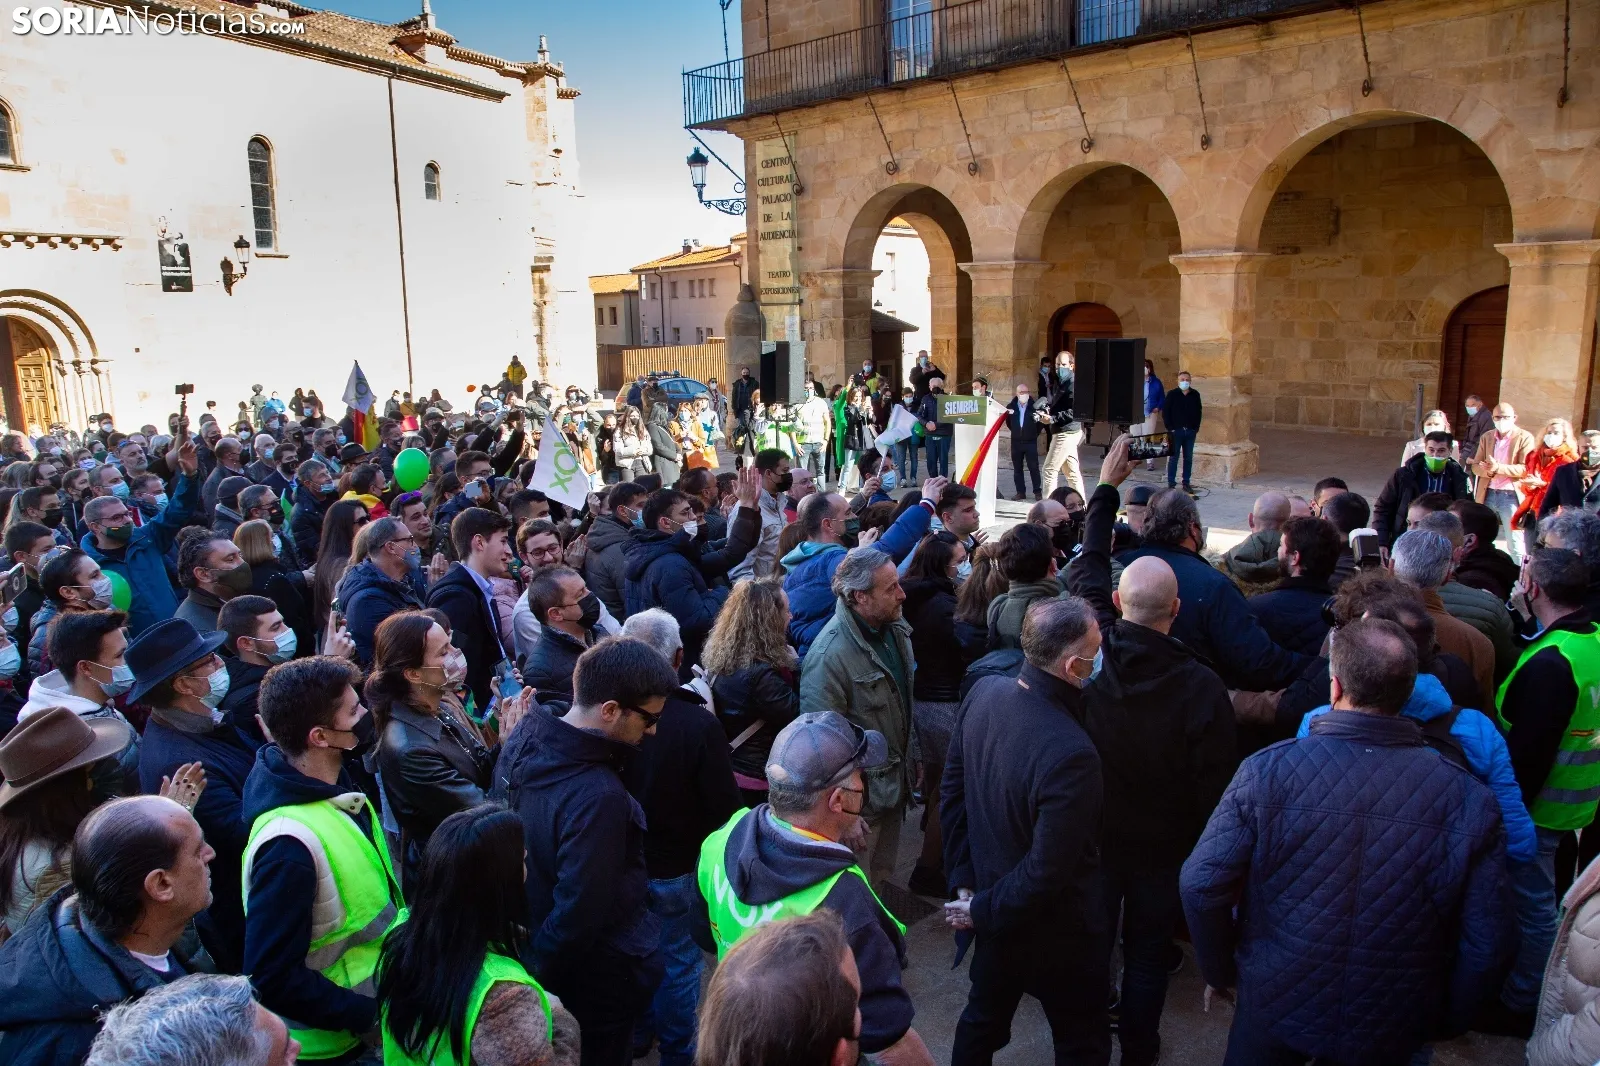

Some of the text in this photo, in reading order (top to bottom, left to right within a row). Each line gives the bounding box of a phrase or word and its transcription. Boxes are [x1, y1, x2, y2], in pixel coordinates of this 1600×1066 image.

[761, 157, 790, 168] CENTRO
[757, 174, 795, 187] CULTURAL
[762, 193, 791, 205] PALACIO
[763, 211, 792, 223] DE LA
[760, 229, 797, 241] AUDIENCIA
[768, 270, 791, 279] TEATRO
[760, 285, 799, 296] EXPOSICIONES
[945, 400, 979, 415] SIEMBRA
